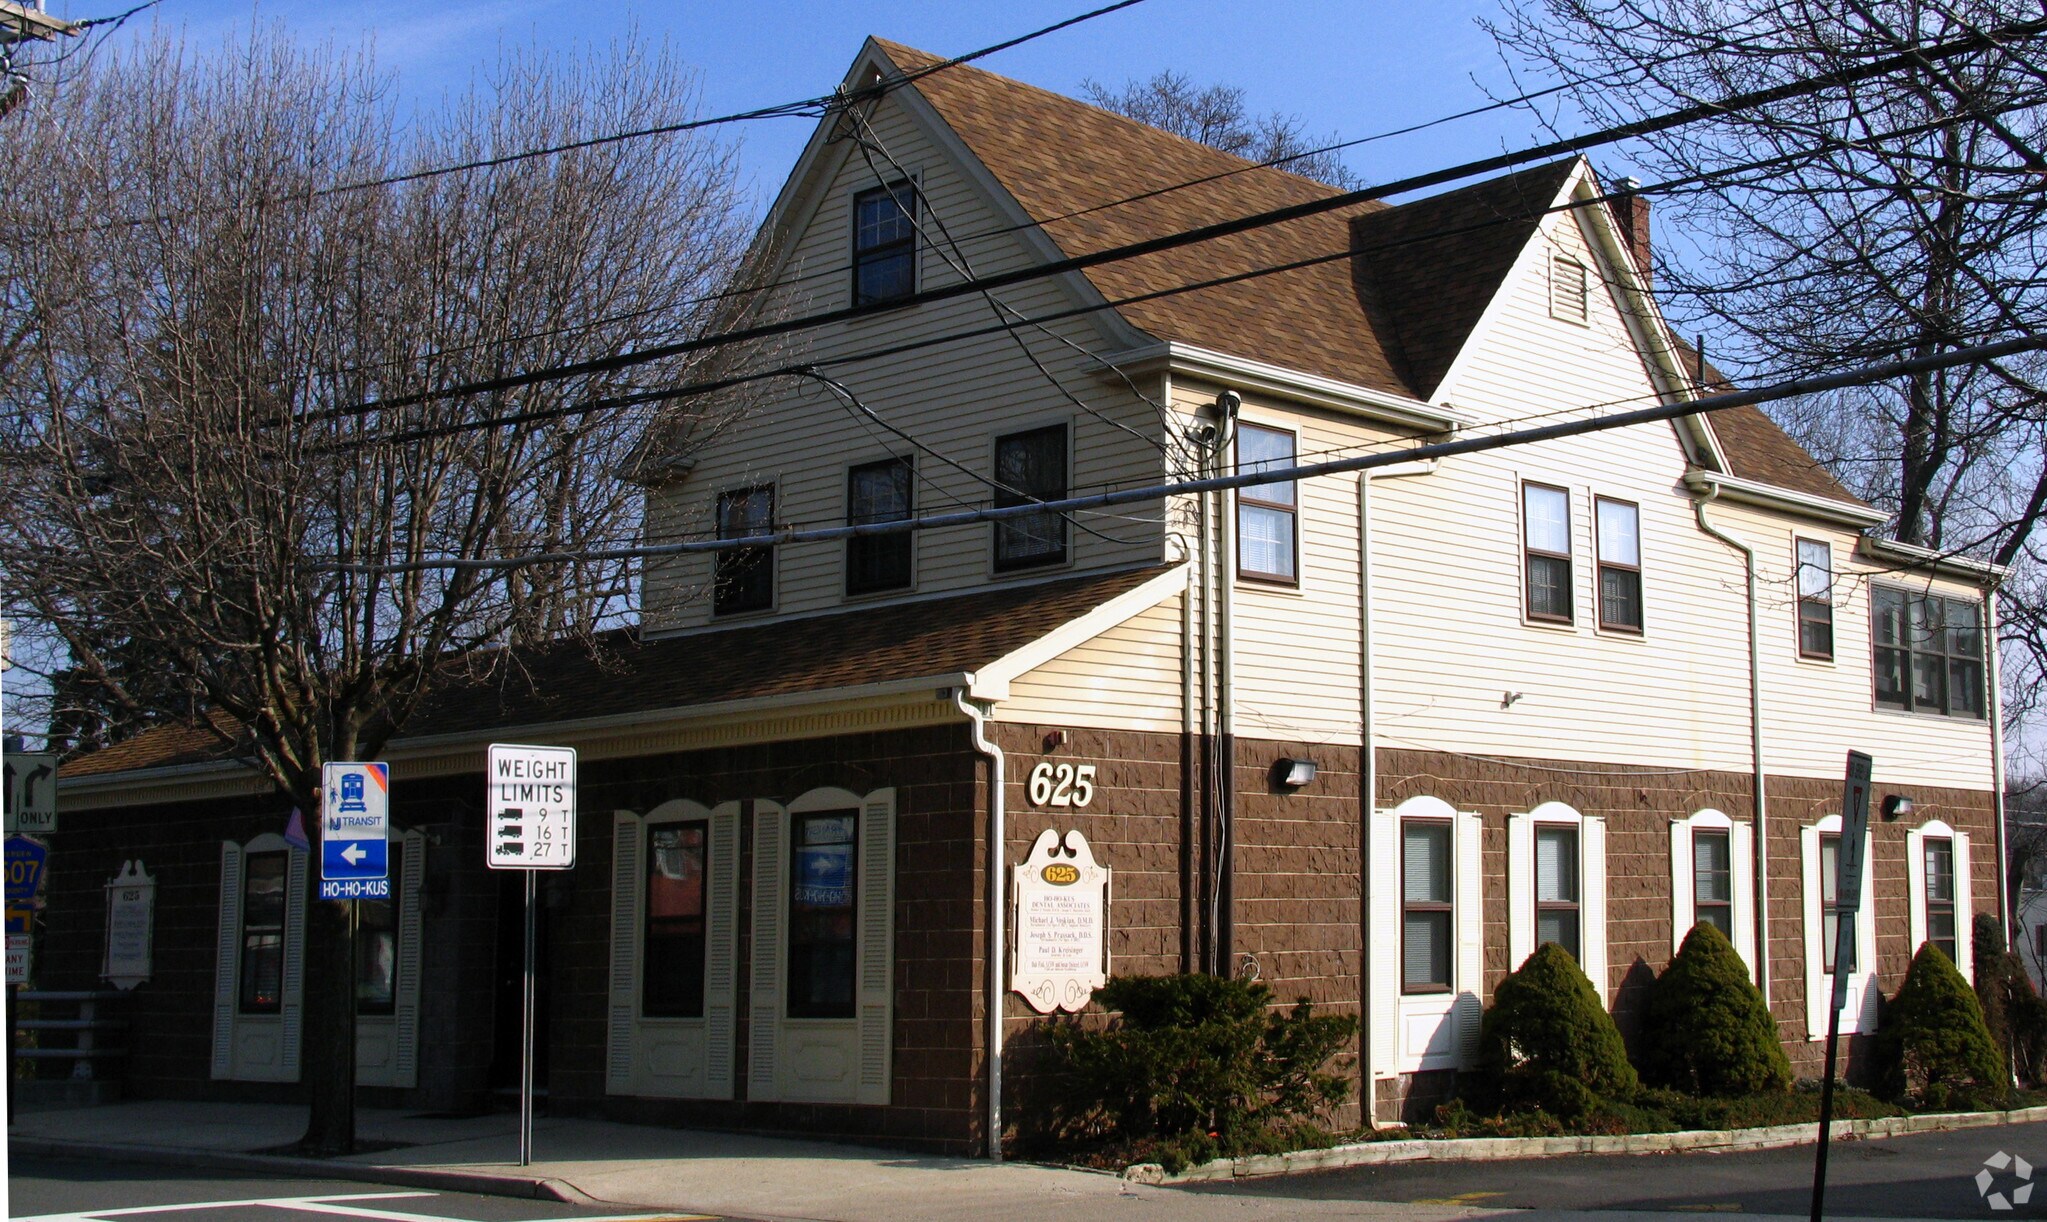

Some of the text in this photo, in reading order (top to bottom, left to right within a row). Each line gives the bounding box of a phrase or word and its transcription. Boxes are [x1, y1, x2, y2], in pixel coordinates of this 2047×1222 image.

[498, 759, 567, 779] WEIGHT
[1030, 762, 1096, 807] 625
[501, 784, 563, 803] LIMITS
[20, 812, 52, 824] ONLY
[539, 808, 568, 822] 9 T
[330, 816, 382, 831] NJ TRANSIT
[537, 825, 568, 840] 16 T
[534, 842, 568, 857] 27 T
[1045, 867, 1076, 882] 625
[123, 890, 140, 902] 625
[323, 881, 388, 897] HO-HO-KUS
[6, 955, 23, 963] ANY
